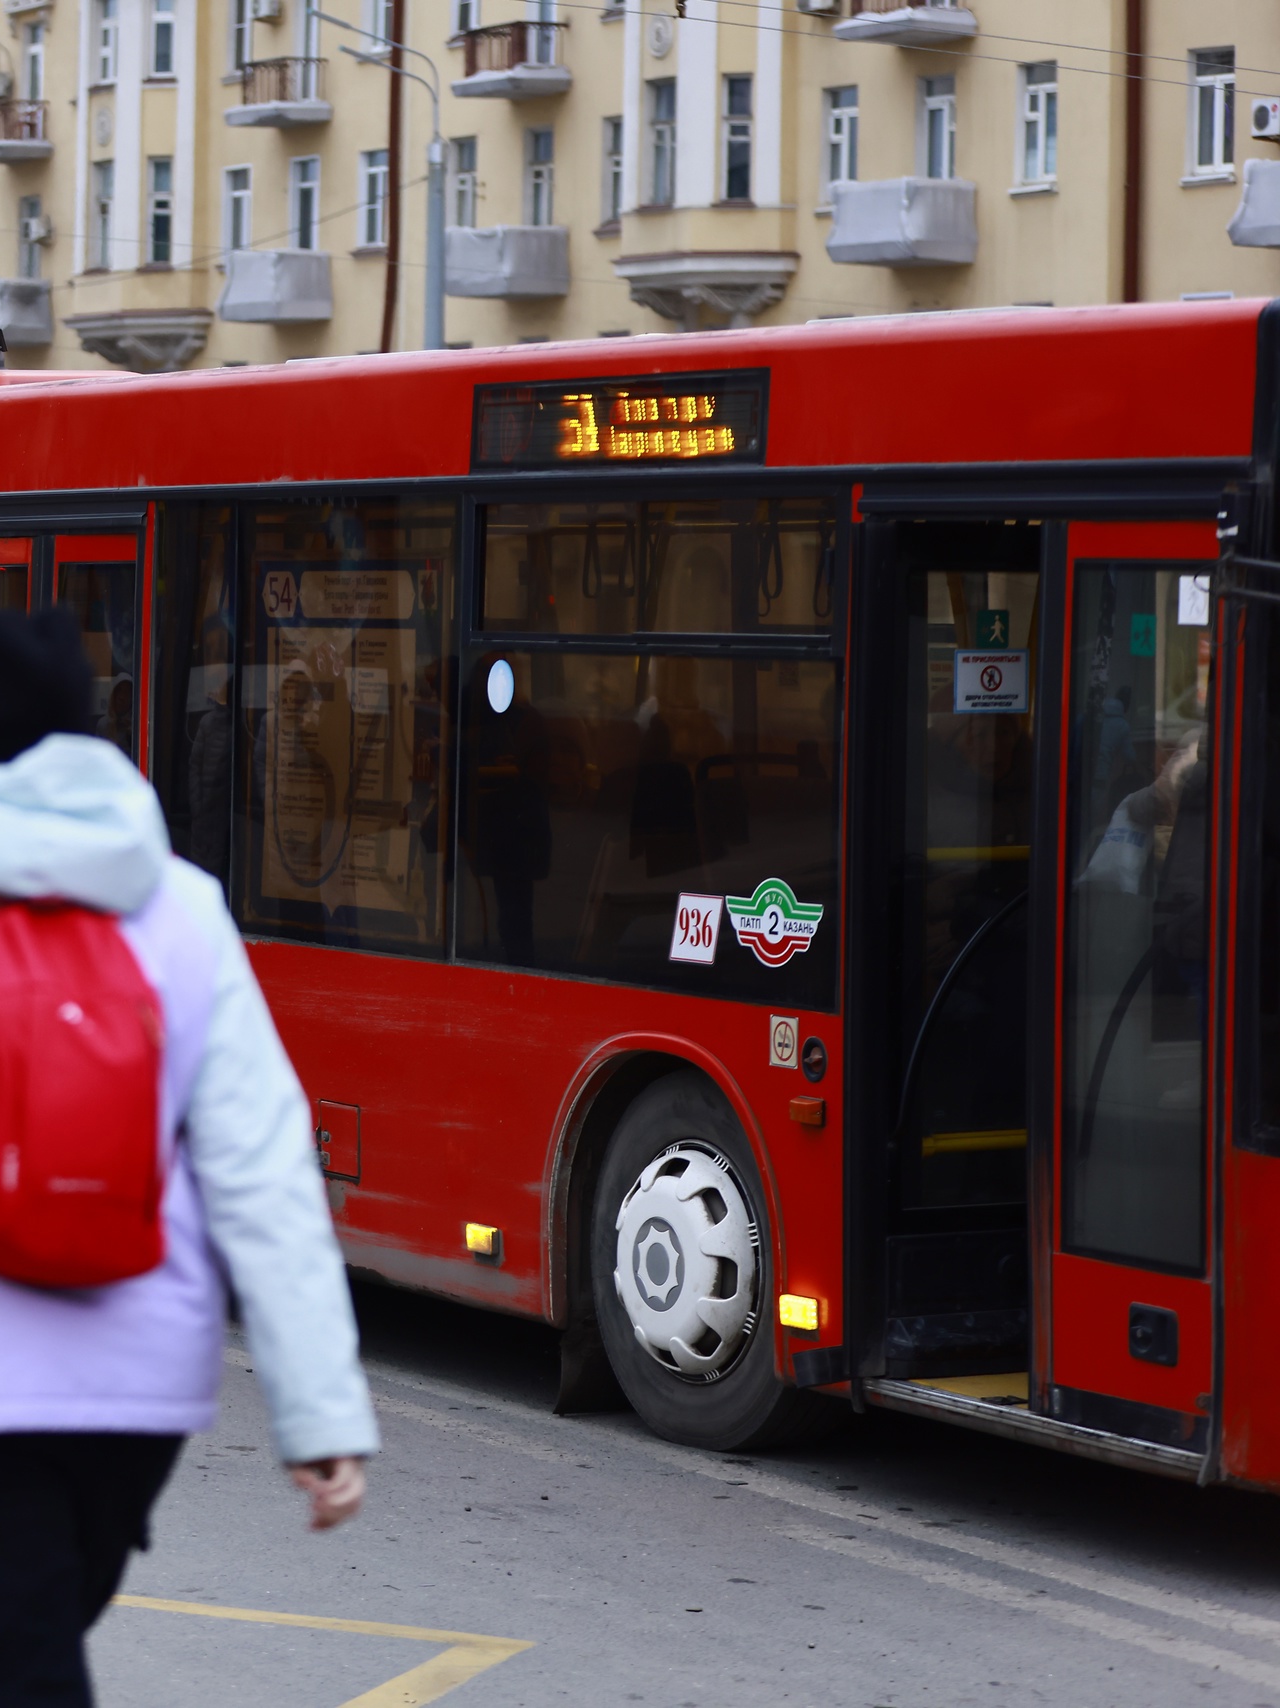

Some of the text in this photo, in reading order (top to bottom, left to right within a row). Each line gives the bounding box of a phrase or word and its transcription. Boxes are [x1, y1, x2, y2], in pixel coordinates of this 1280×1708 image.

[268, 577, 293, 612] 54
[679, 907, 713, 948] 936
[740, 911, 814, 935] ПАТП 2 КАЗАНЬ
